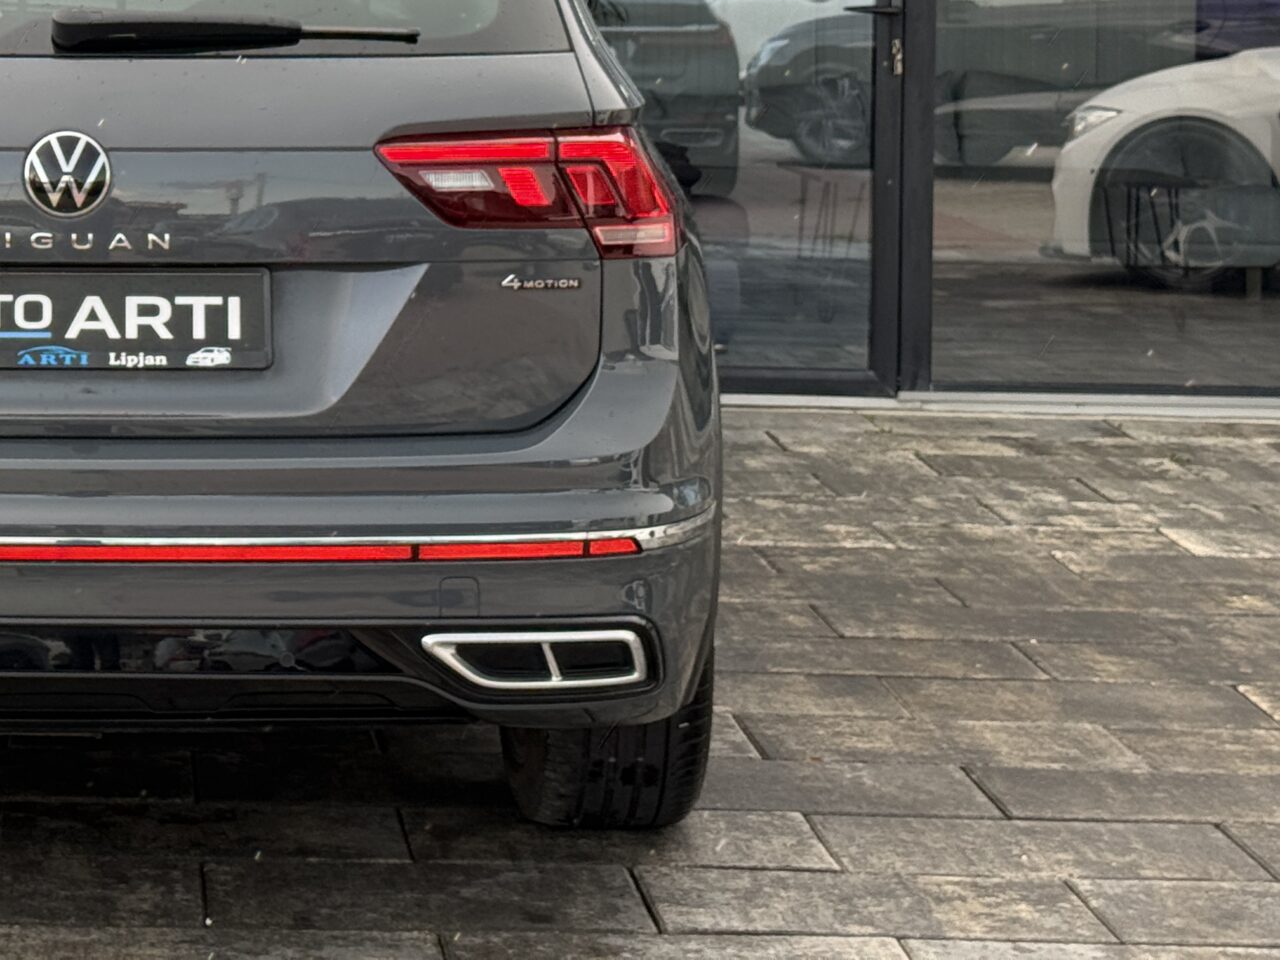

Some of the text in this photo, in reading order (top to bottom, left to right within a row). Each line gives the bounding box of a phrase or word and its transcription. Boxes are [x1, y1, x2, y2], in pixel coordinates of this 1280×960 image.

[501, 273, 579, 290] 4MOTION
[64, 295, 242, 340] ARTI
[17, 352, 89, 366] ARTI
[108, 351, 168, 368] Lipjan
